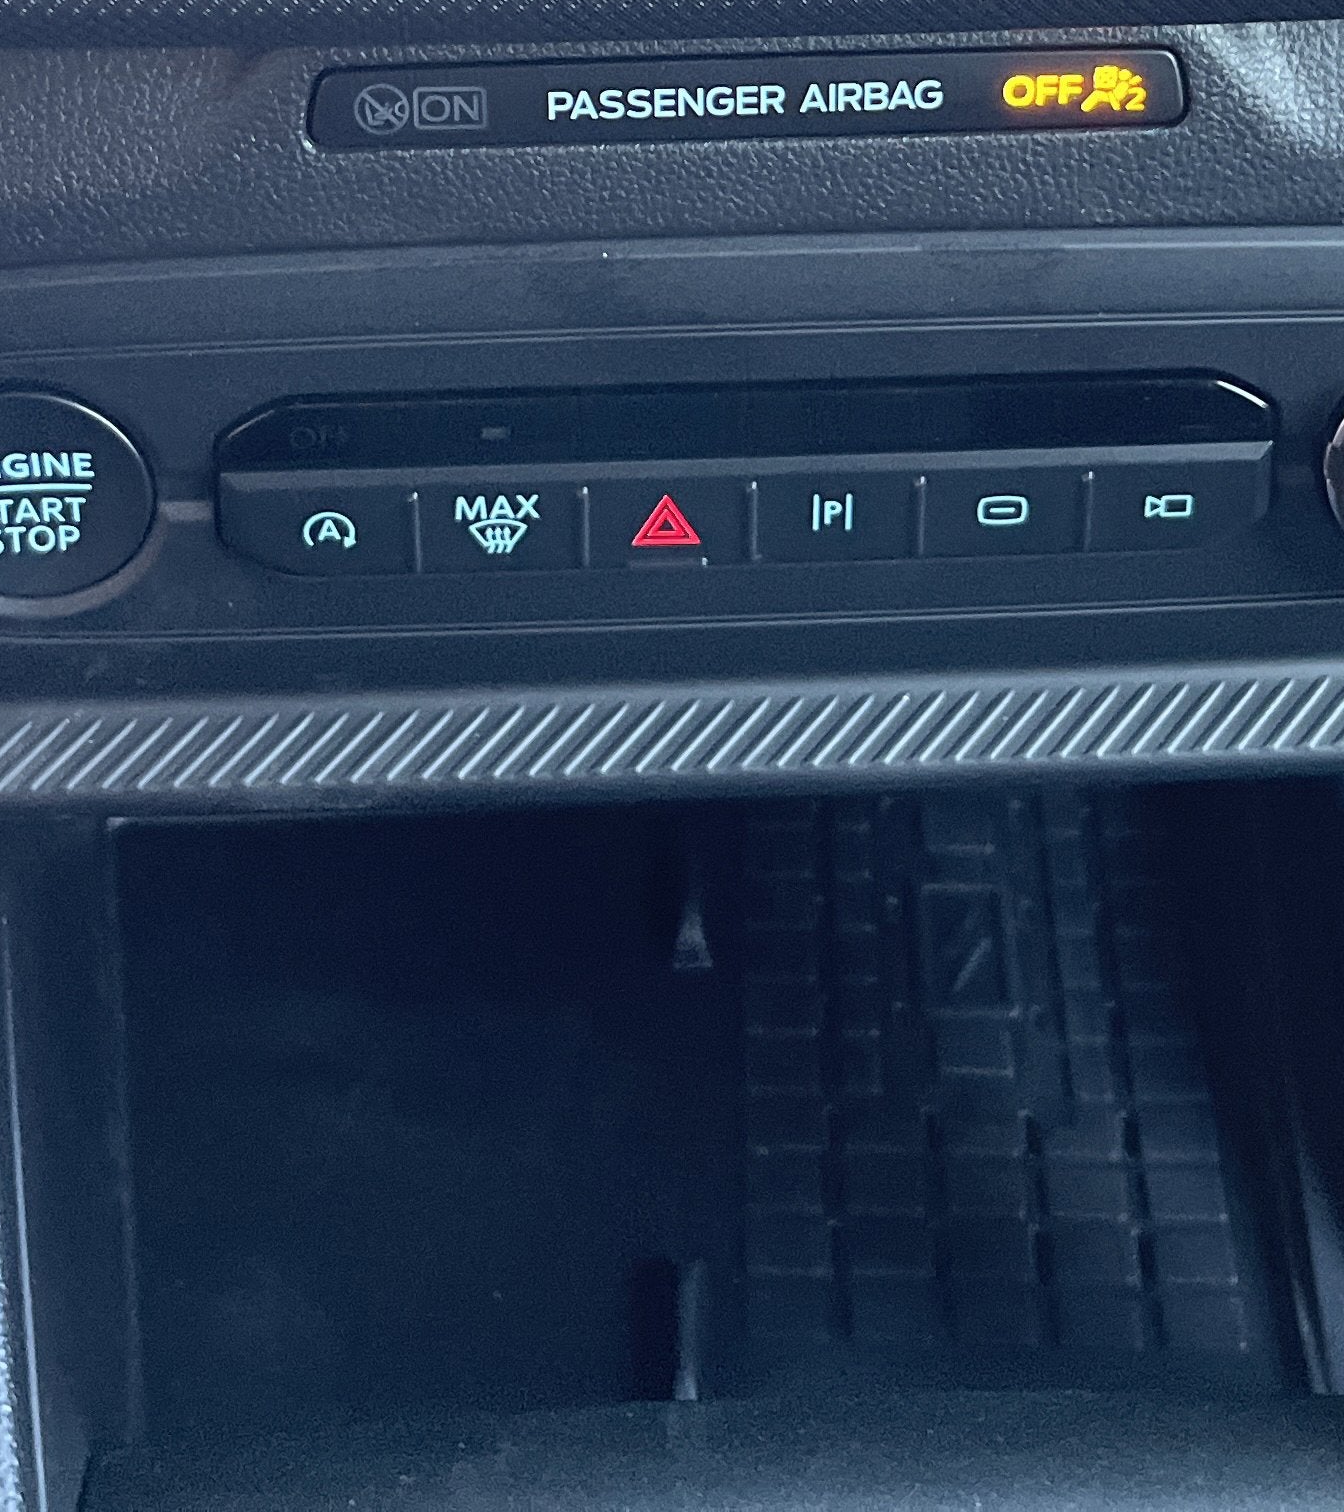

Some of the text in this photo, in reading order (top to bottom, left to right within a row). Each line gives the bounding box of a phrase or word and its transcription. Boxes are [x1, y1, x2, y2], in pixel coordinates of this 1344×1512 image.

[547, 79, 944, 121] PASSENGER AIRBAG
[1002, 74, 1084, 108] OFF
[421, 94, 479, 122] ON
[455, 494, 541, 521] MAX
